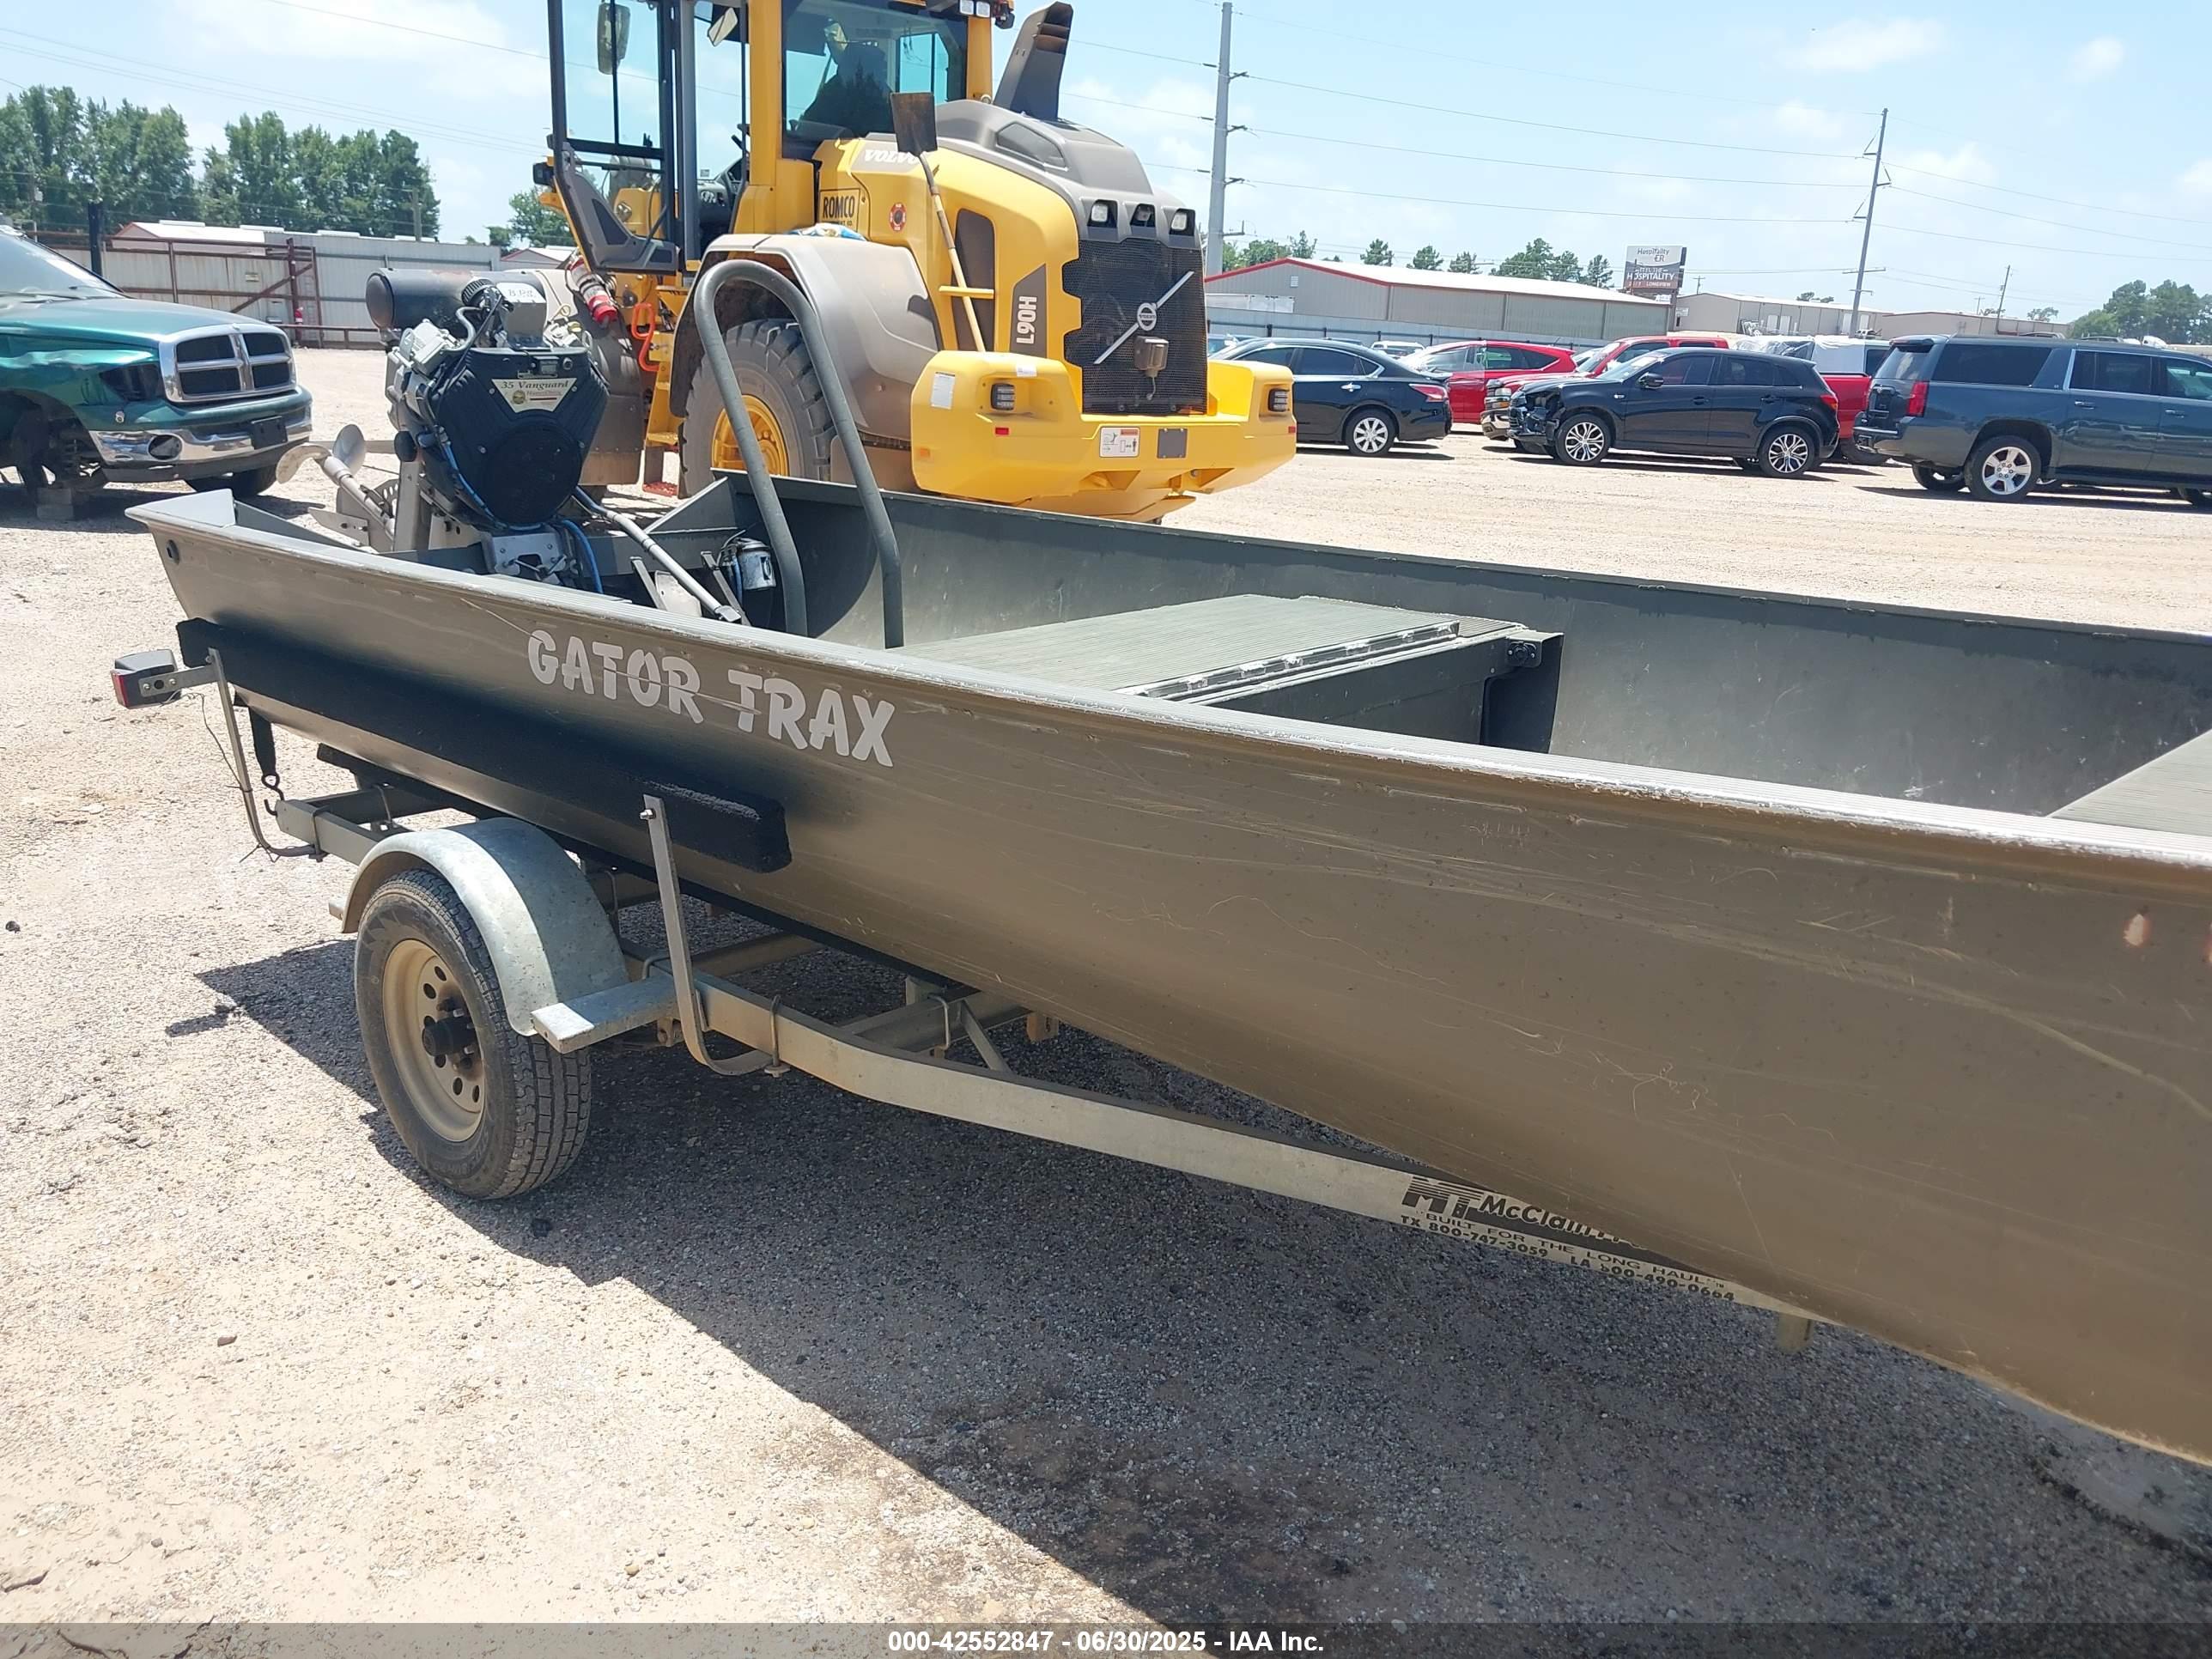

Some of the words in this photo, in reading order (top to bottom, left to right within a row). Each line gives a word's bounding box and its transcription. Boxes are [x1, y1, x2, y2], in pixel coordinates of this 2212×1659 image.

[864, 149, 920, 165] VOLVO
[823, 196, 855, 219] ROMCO
[1626, 272, 1675, 281] HOSPITALITY
[1016, 295, 1037, 344] L90H
[501, 380, 514, 389] 35
[518, 380, 569, 391] Vanguard
[526, 629, 704, 724] GATOR
[727, 668, 896, 768] TRAX
[1401, 1214, 1421, 1227] TX
[1428, 1222, 1549, 1258] 800-747-3059
[1570, 1255, 1591, 1268] LA
[1487, 1227, 1526, 1243] FOR
[1538, 1239, 1575, 1254] THE
[1586, 1251, 1641, 1270] LONG
